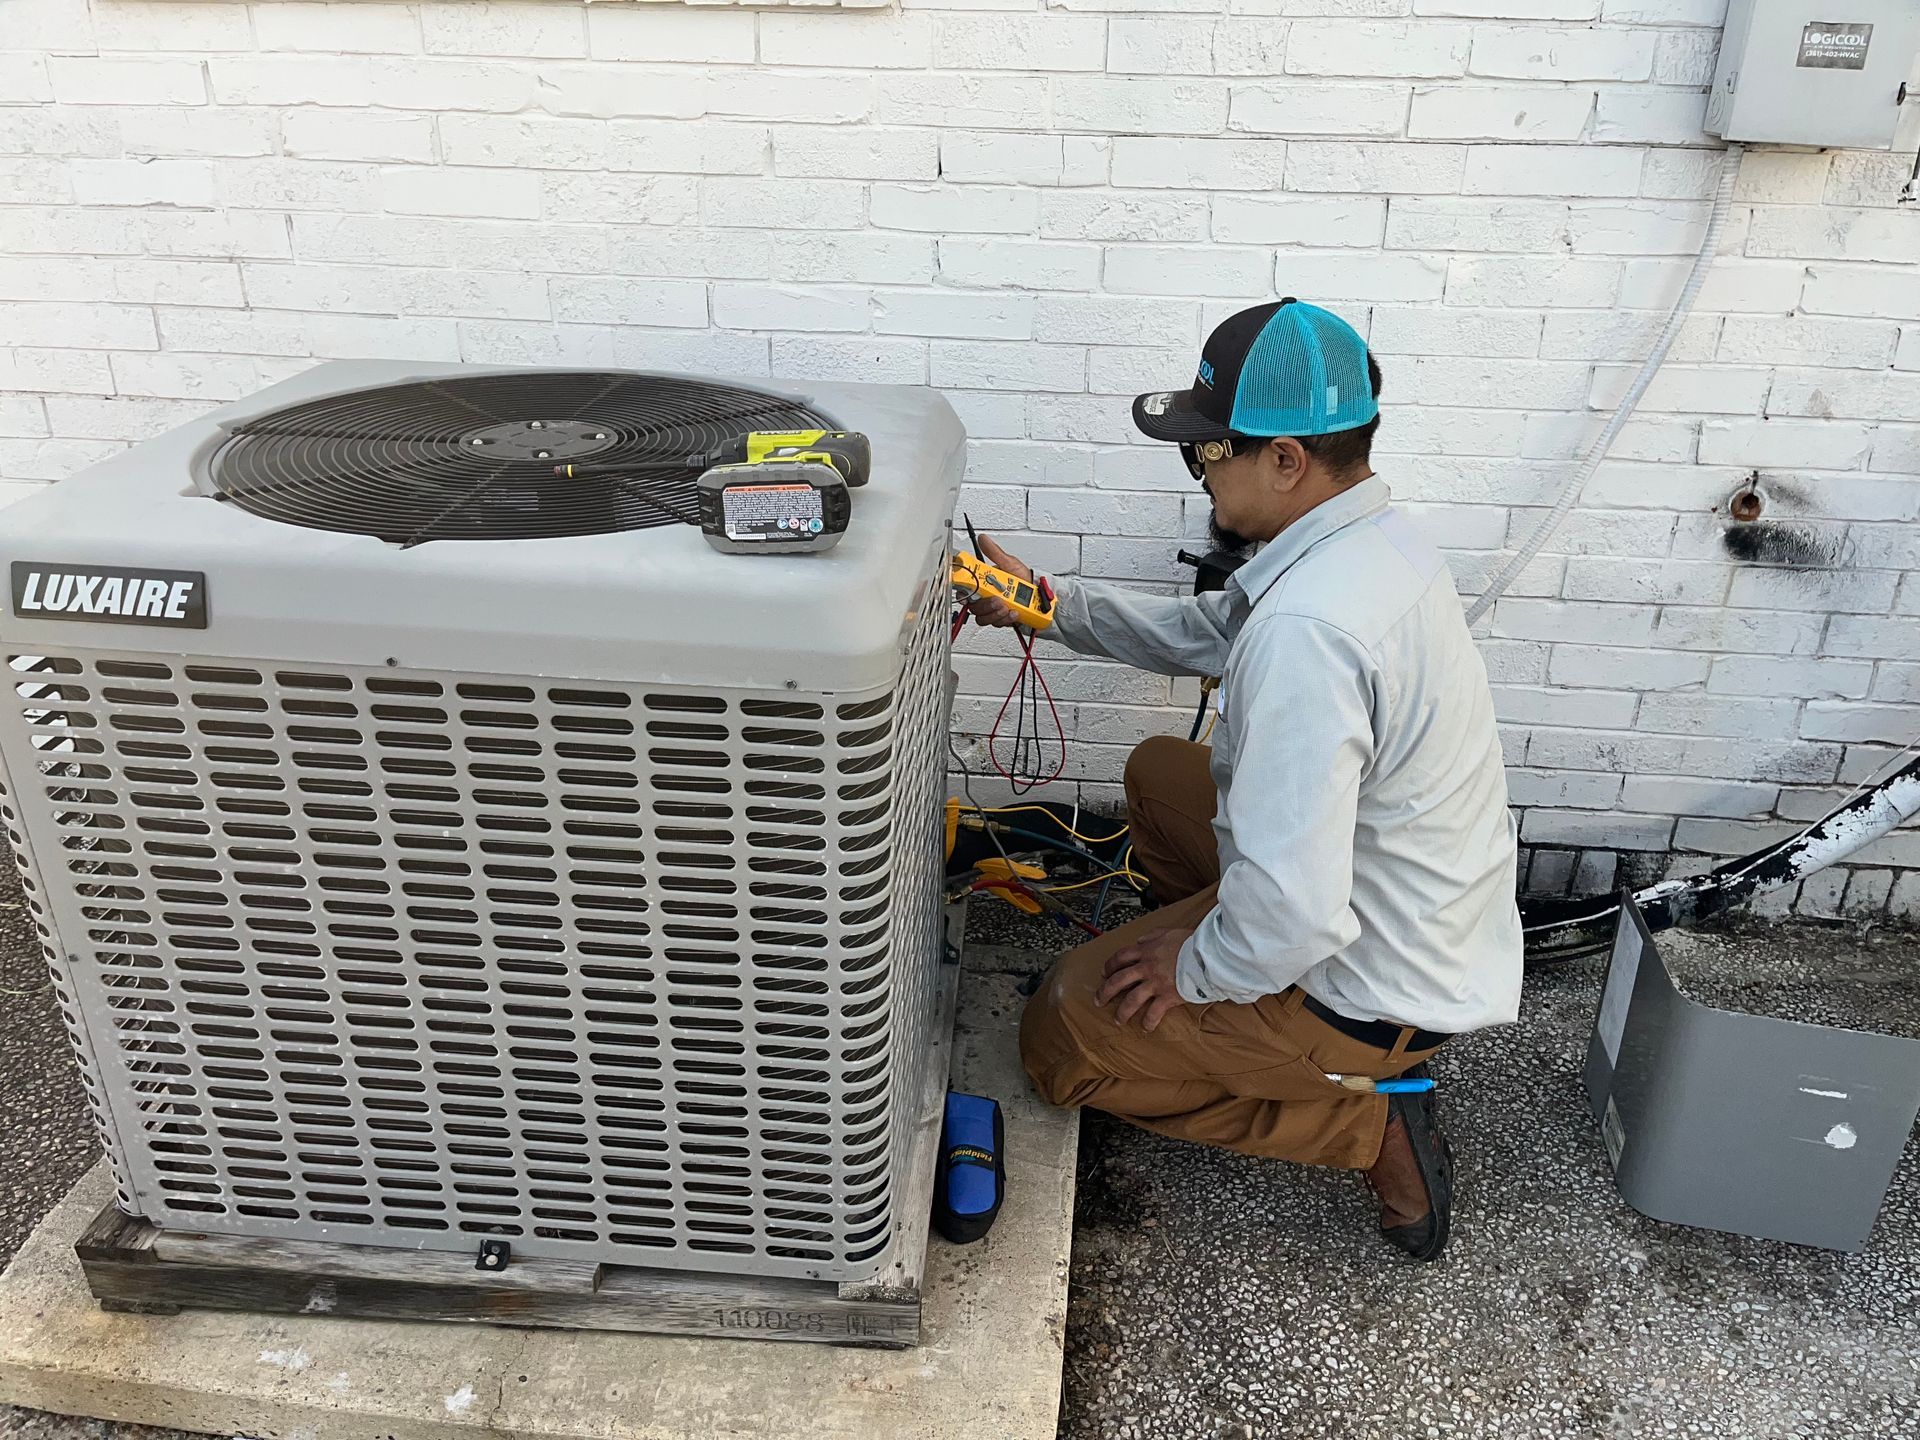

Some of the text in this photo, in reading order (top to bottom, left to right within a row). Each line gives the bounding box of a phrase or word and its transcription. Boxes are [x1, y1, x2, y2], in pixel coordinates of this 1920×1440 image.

[1804, 32, 1867, 46] LOGICOOL
[21, 572, 194, 619] LUXAIRE
[712, 1308, 824, 1333] 110088
